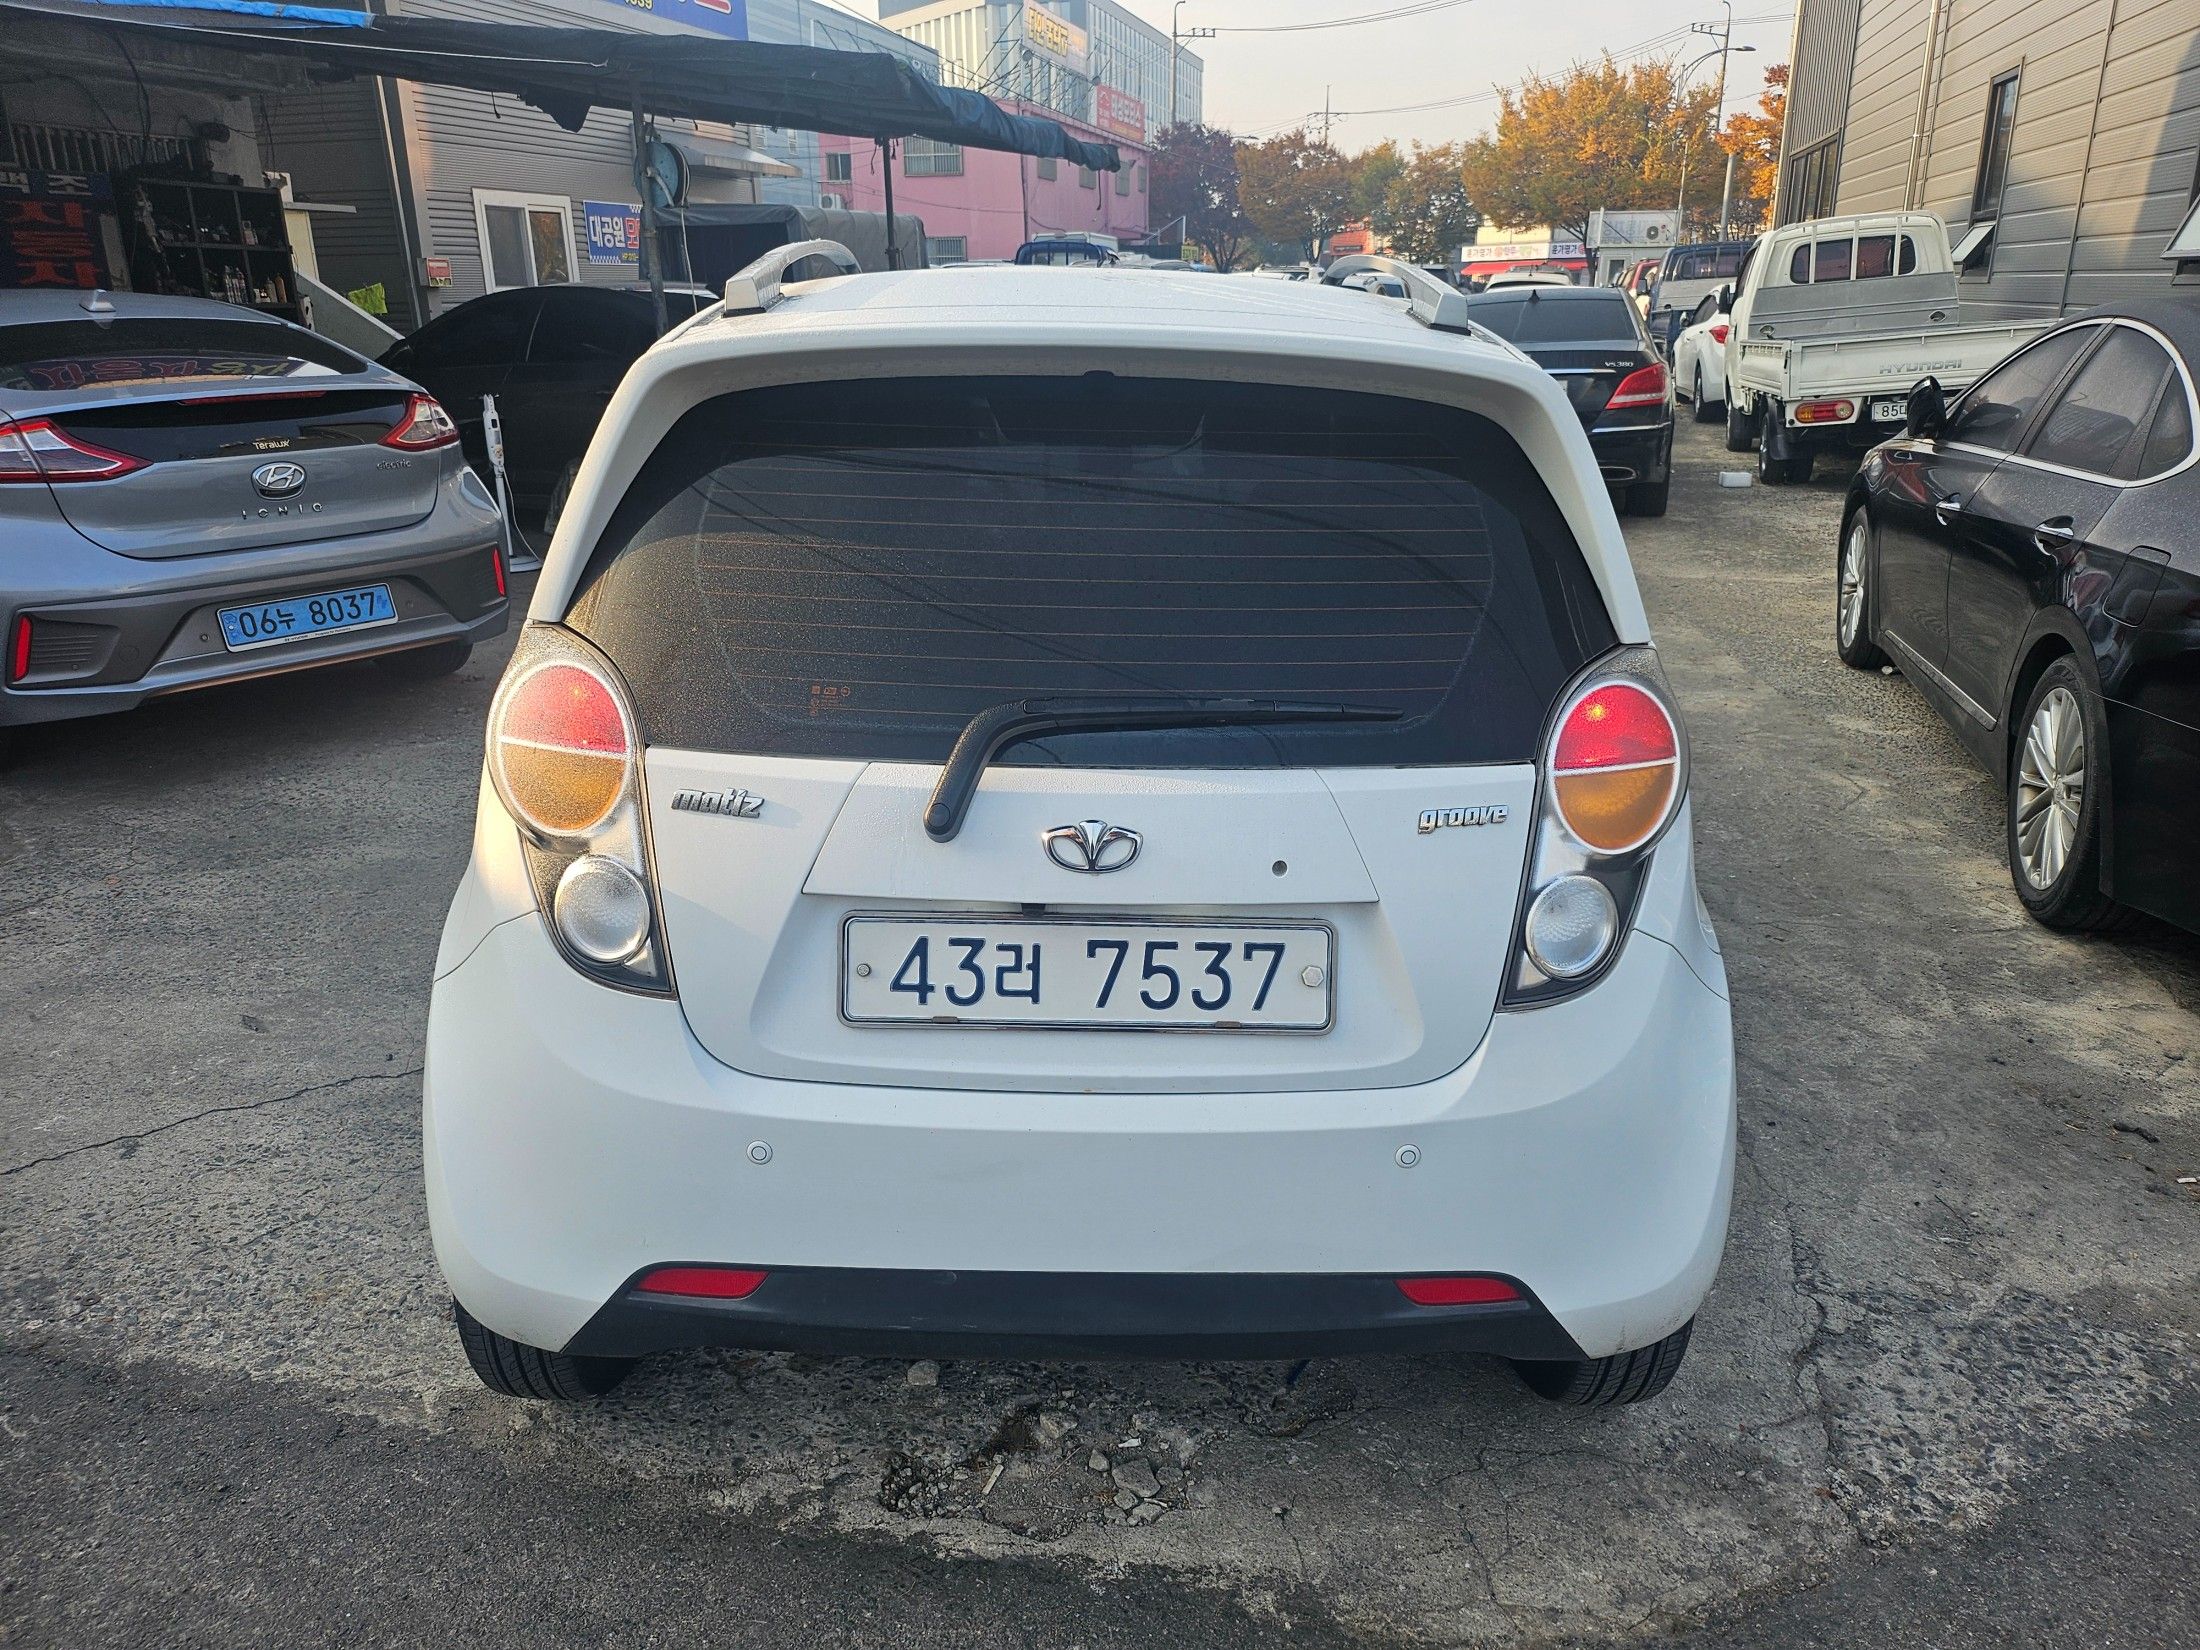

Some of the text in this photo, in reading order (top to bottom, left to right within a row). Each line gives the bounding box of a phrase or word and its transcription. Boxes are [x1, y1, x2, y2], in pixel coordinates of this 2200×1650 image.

[1880, 359, 1962, 374] HYUNDAI
[252, 439, 290, 450] Teralux
[376, 459, 412, 470] electric
[241, 502, 323, 520] IONIQ
[239, 591, 376, 638] 06누 8037
[671, 787, 765, 818] matiz
[1418, 805, 1508, 834] groove
[889, 935, 1286, 1011] 43러 7537
